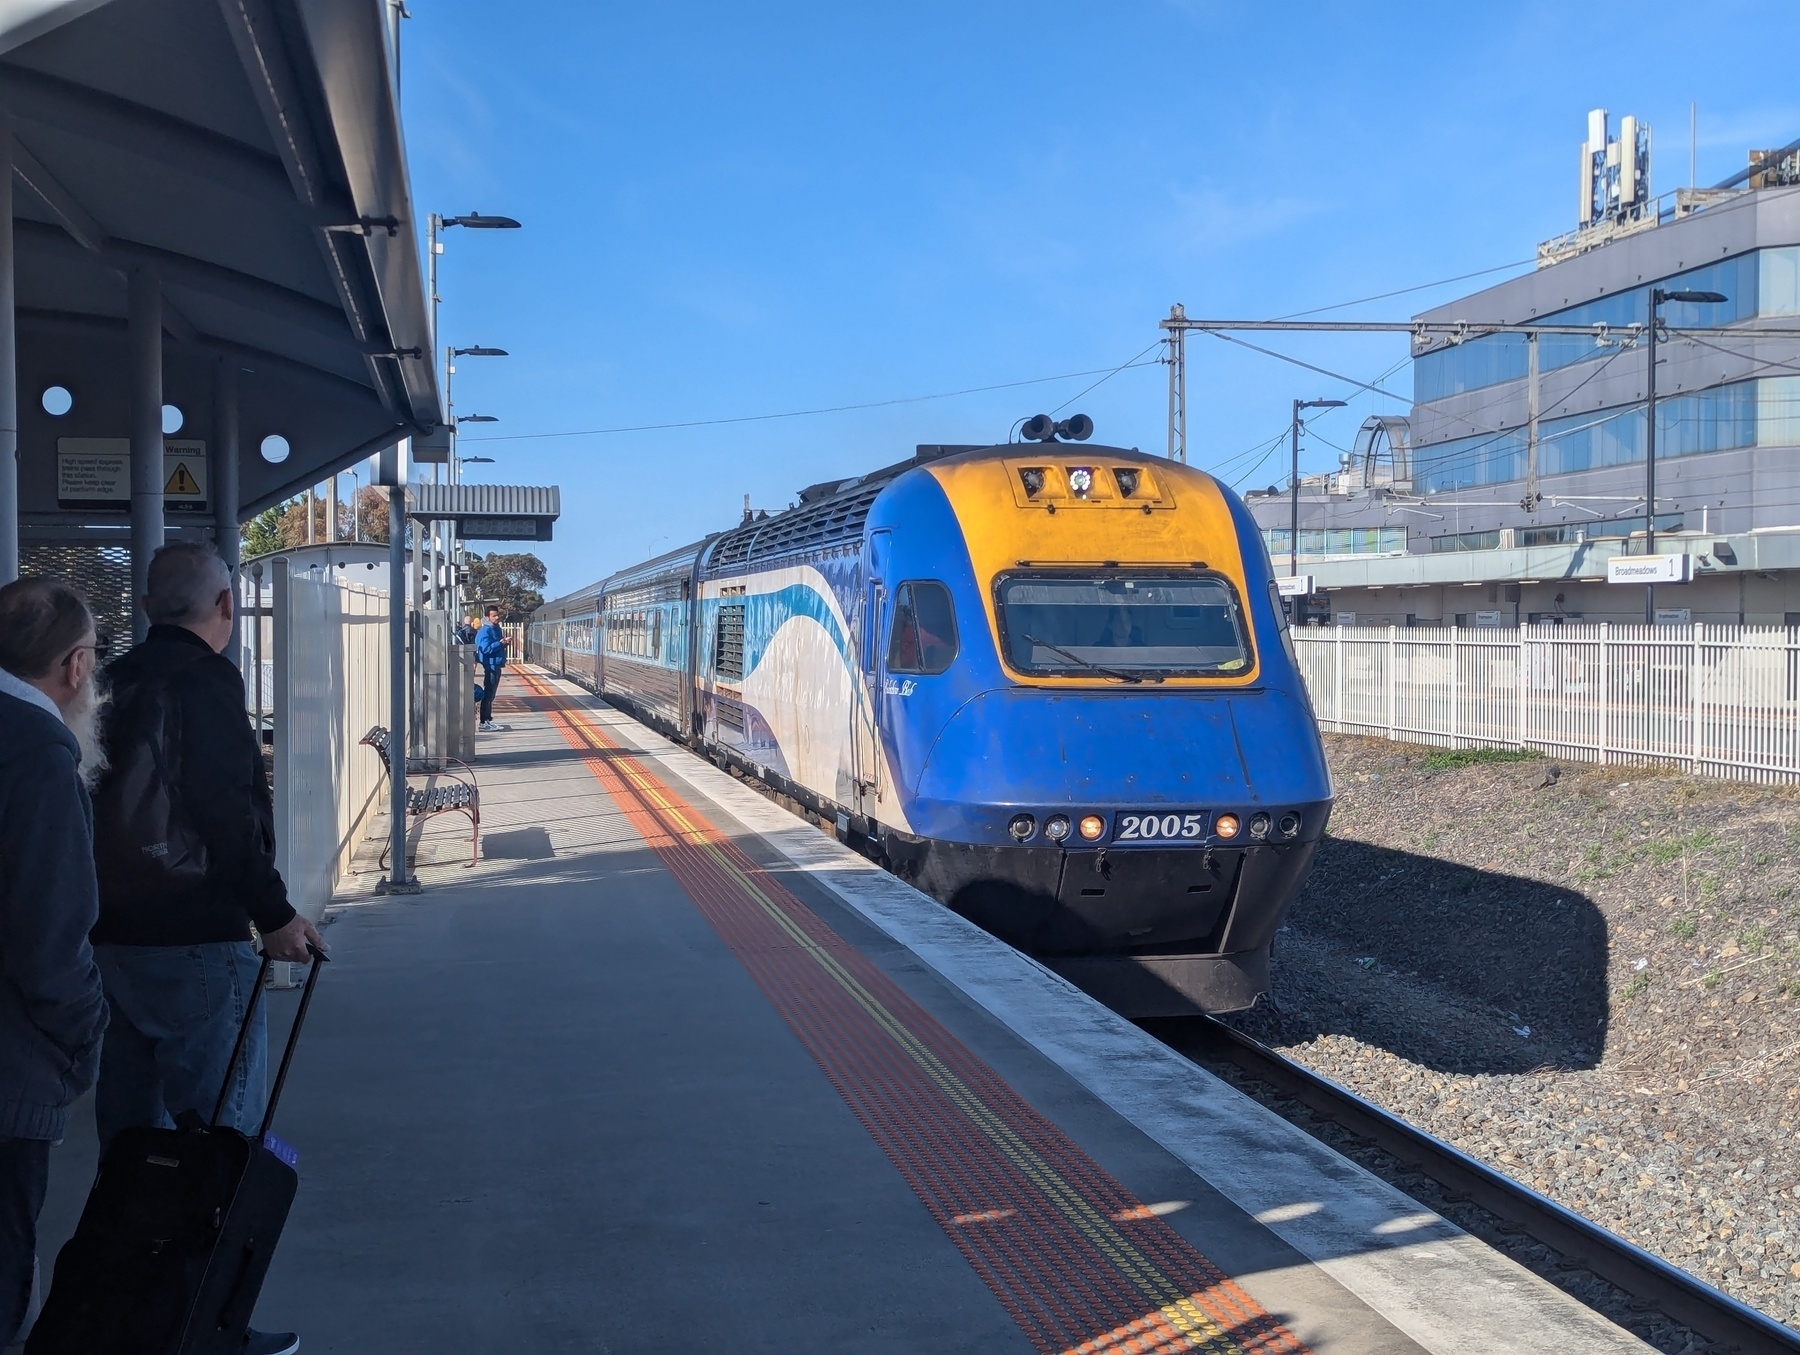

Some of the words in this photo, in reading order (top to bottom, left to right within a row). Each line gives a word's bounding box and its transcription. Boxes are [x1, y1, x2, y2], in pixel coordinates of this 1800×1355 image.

[165, 446, 201, 455] Warning
[1615, 566, 1658, 576] Broadmeadows
[1669, 558, 1674, 577] 1
[1120, 815, 1202, 839] 2005
